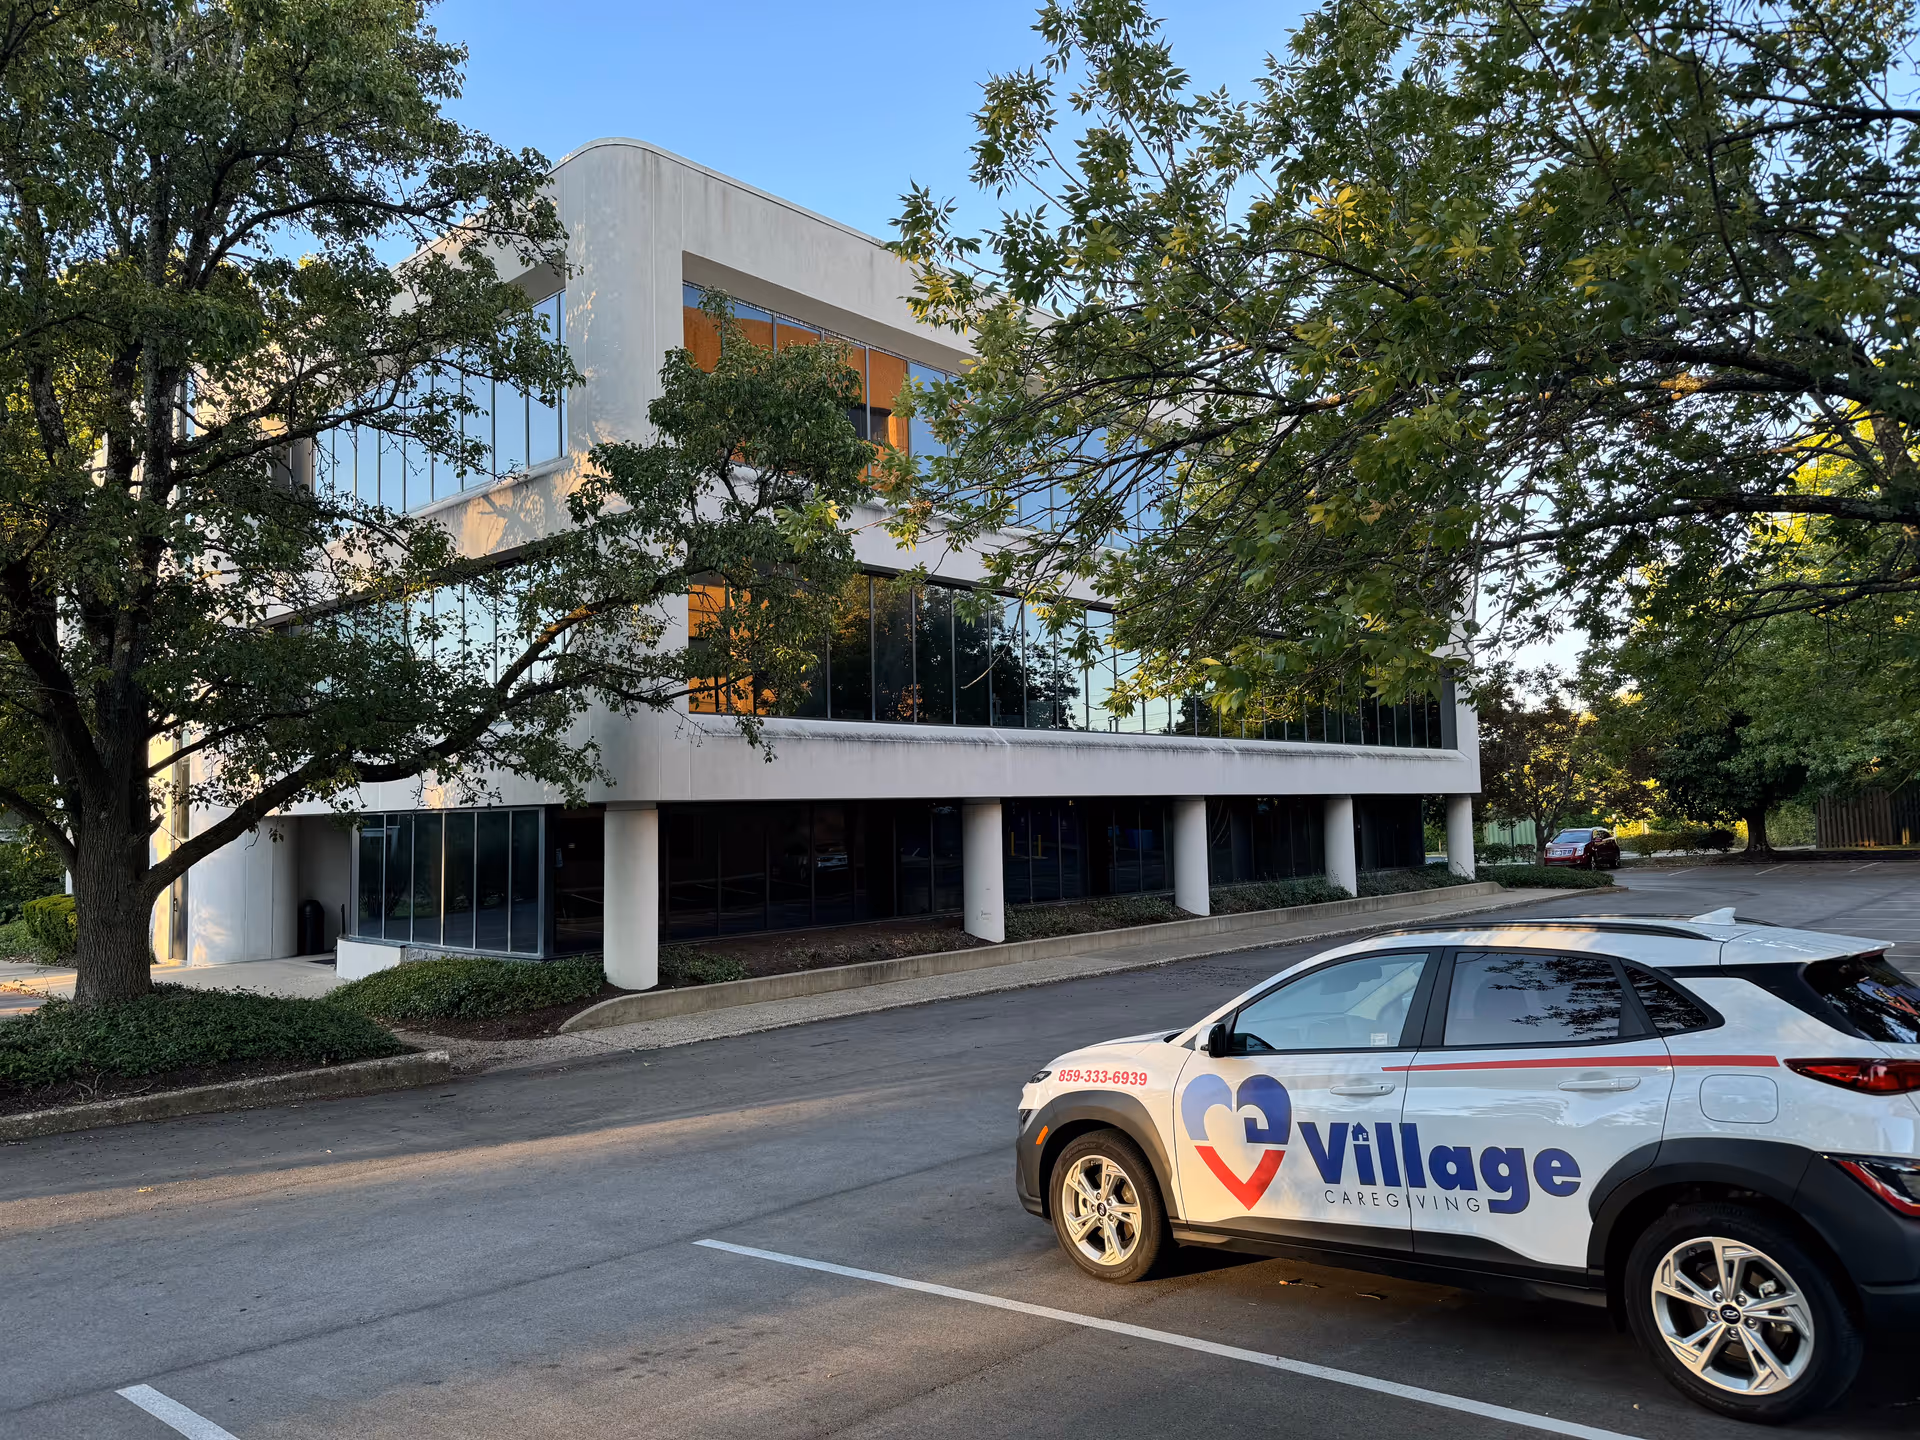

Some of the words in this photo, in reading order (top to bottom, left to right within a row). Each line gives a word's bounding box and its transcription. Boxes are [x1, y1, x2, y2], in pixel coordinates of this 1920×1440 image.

[1058, 1069, 1148, 1086] 859-333-6939
[1297, 1121, 1582, 1214] Village
[1324, 1189, 1480, 1212] CAREGIVING
